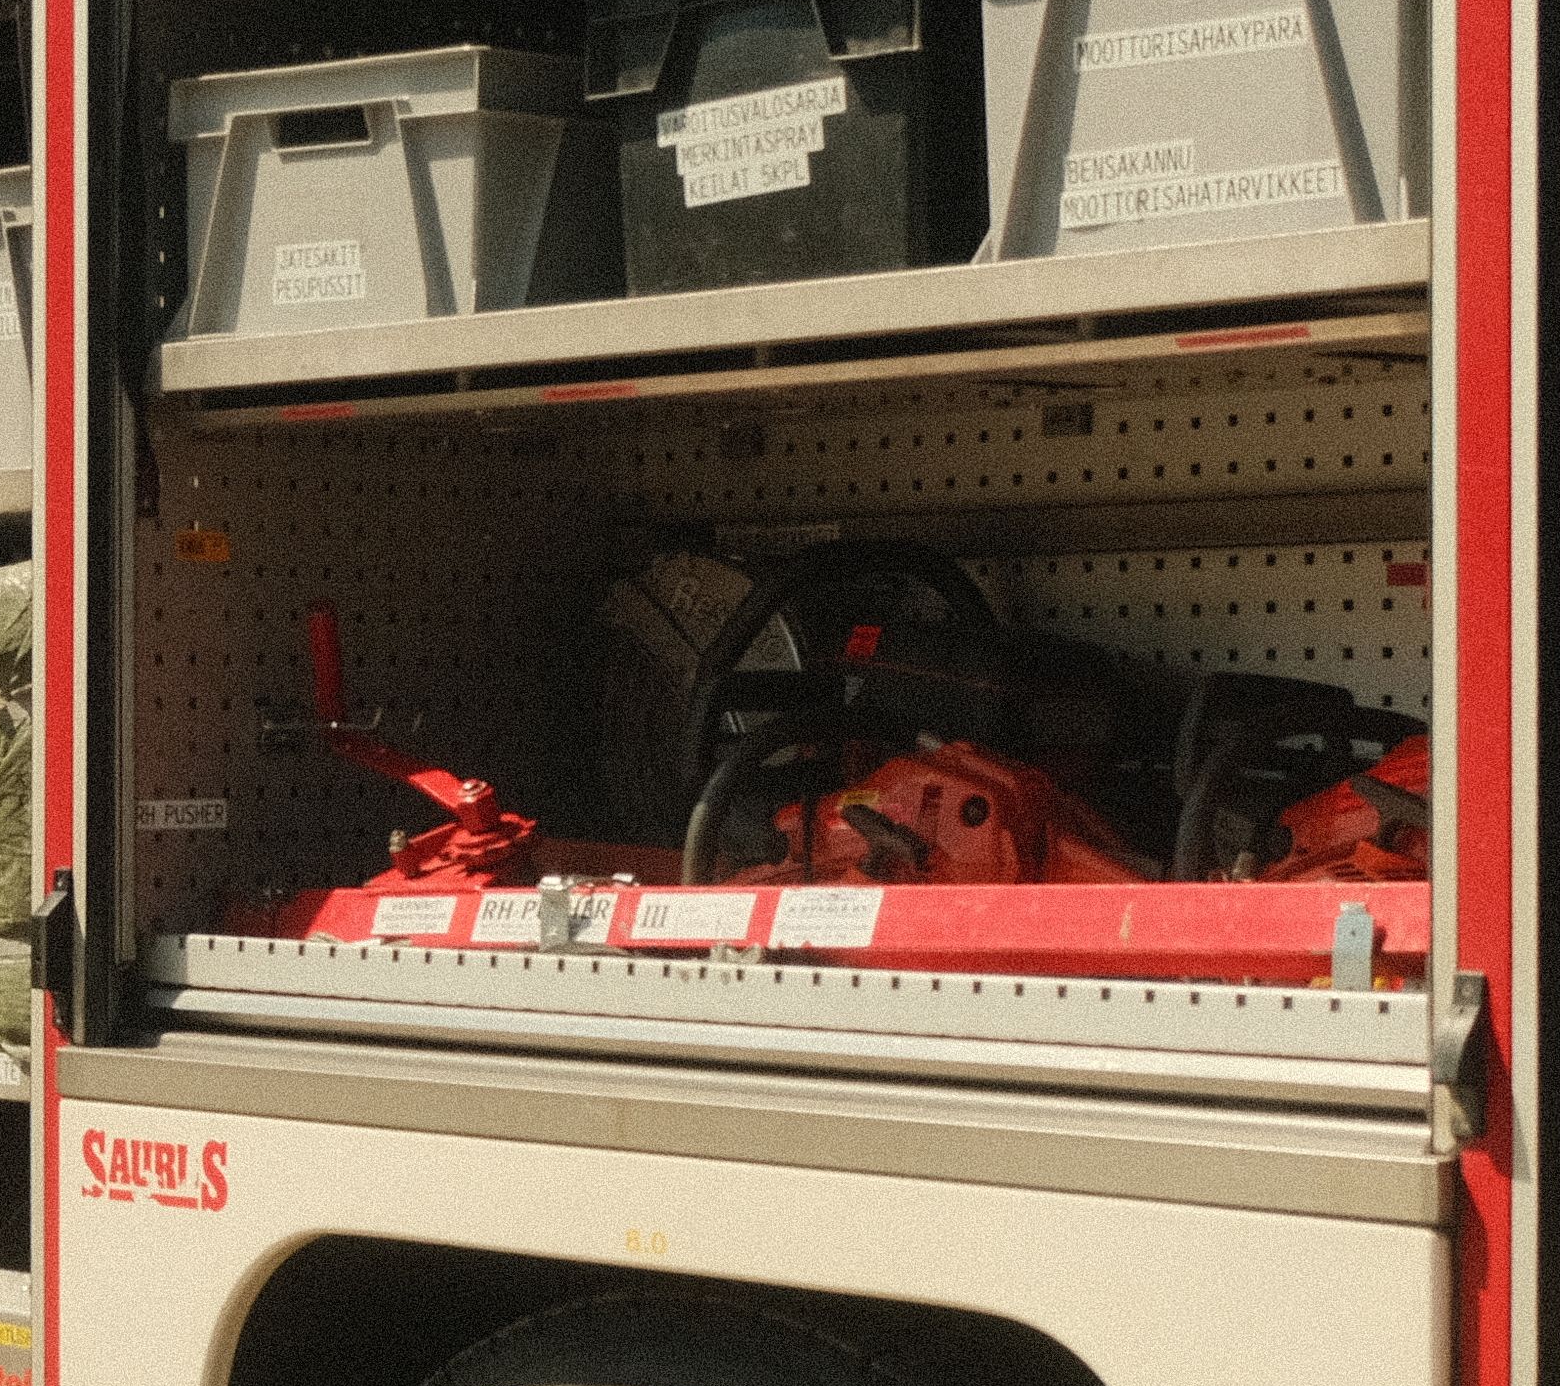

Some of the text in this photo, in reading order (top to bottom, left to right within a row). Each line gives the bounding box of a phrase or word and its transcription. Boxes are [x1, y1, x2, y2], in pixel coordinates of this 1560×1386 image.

[689, 159, 806, 199] KEILAT 5KPL
[1067, 143, 1192, 185] BENSAKANNU
[1062, 165, 1341, 223] MOOTTORISAHATARVIKKEET
[164, 803, 224, 825] PUSHER
[482, 899, 514, 921] RH
